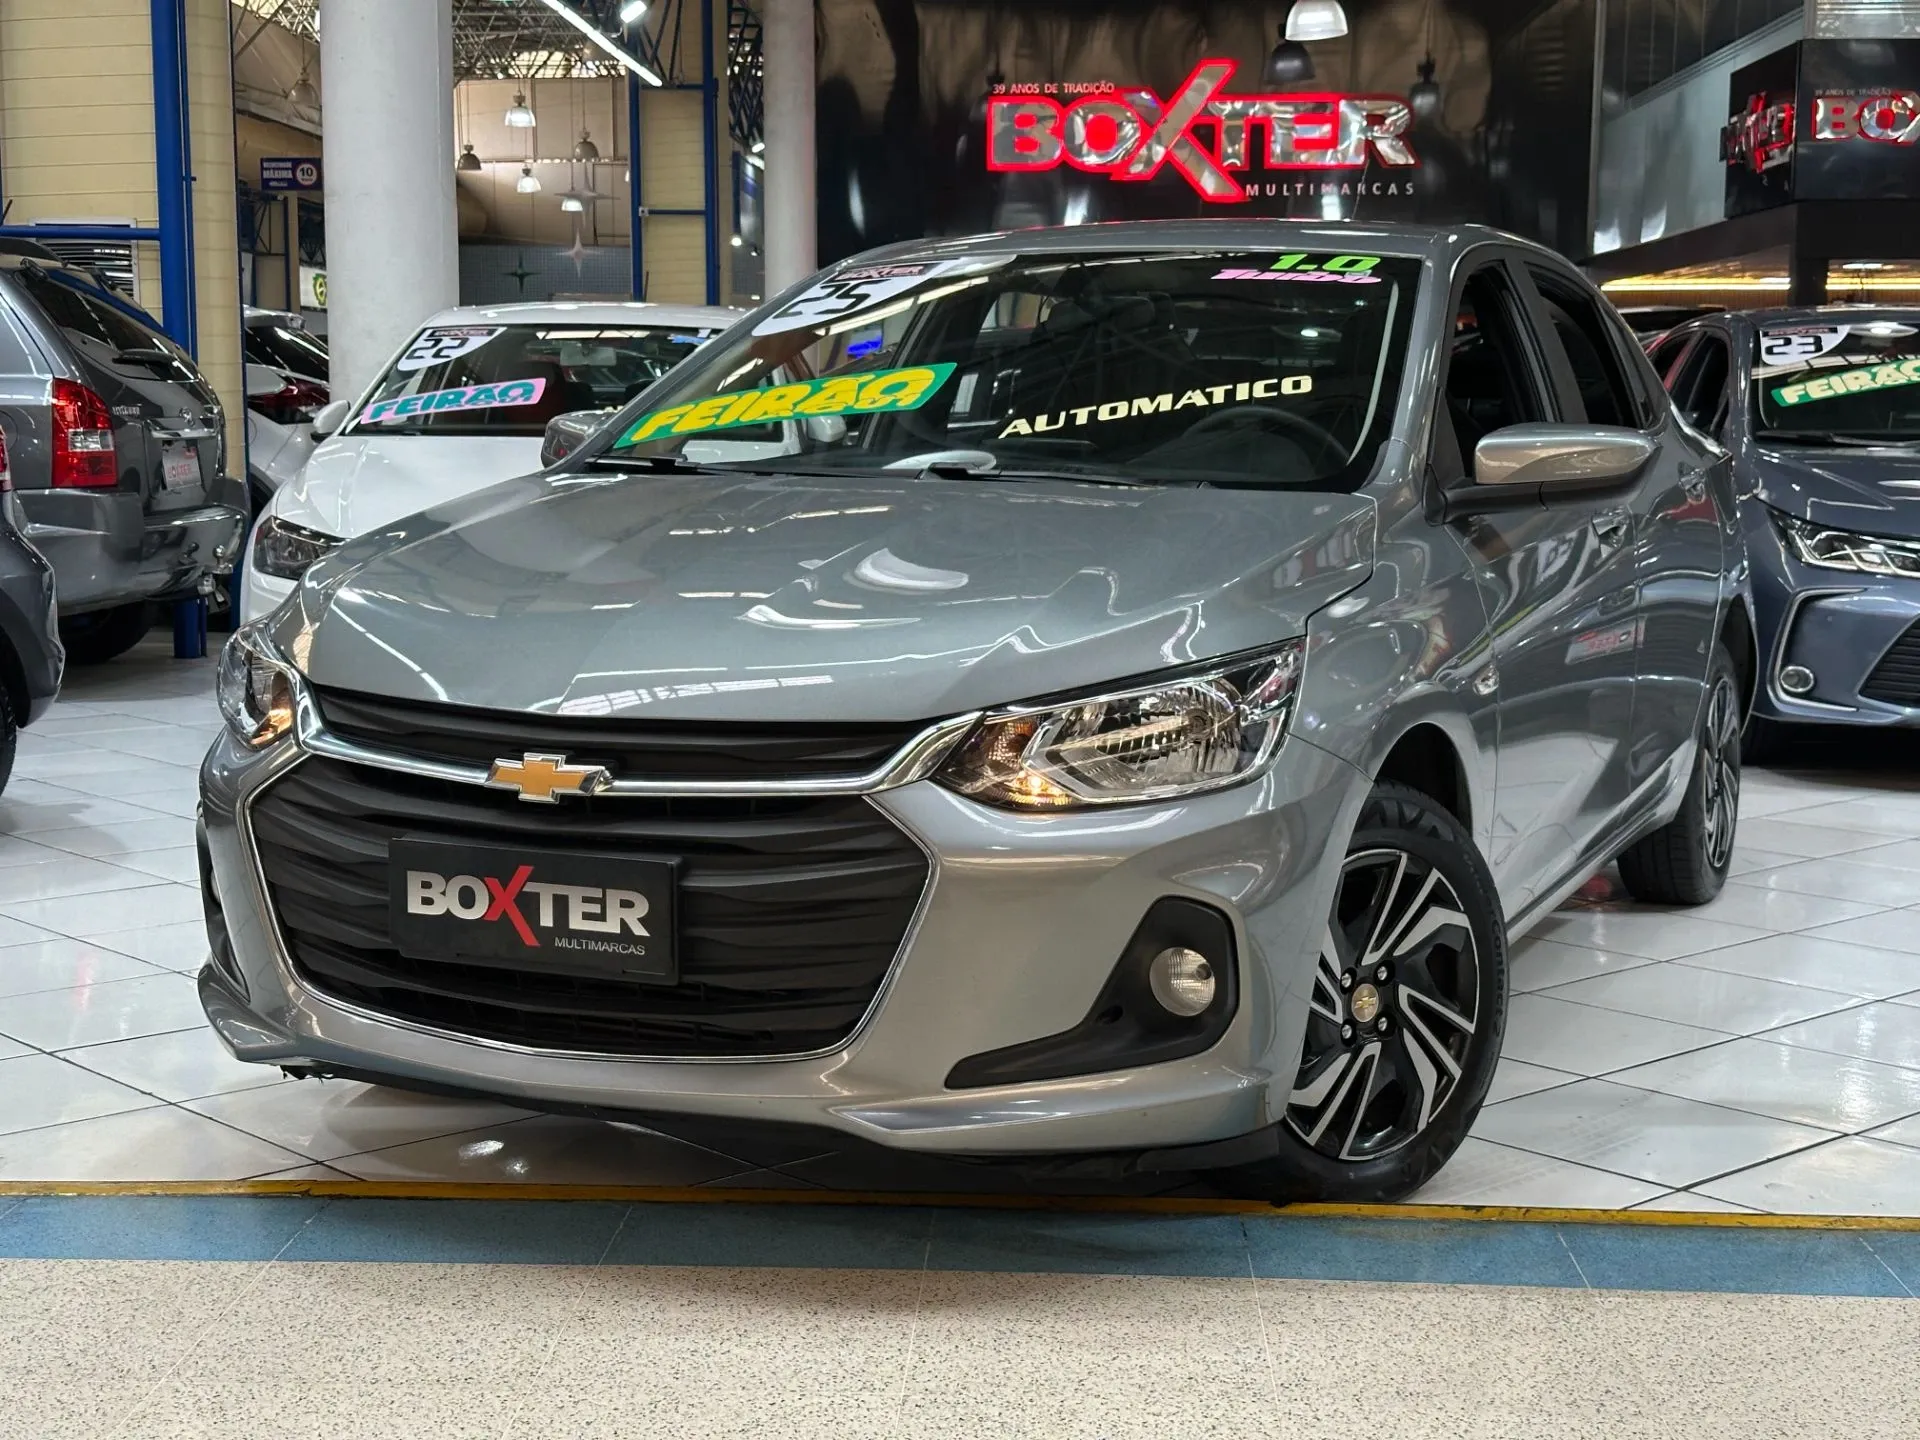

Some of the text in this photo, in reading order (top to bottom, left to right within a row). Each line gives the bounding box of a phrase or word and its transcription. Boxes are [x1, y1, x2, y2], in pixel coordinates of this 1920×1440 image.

[992, 80, 1115, 95] 39 ANOS DE TRADIÇÃO
[988, 58, 1420, 203] BOXTER
[300, 166, 313, 177] 10
[1245, 182, 1415, 196] MULTIMARCAS
[1270, 254, 1381, 271] 1.0
[772, 279, 892, 319] 25
[405, 337, 470, 360] 22
[1765, 335, 1824, 355] 23
[406, 865, 651, 947] BOXTER
[554, 937, 645, 955] MULTIMARCAS
